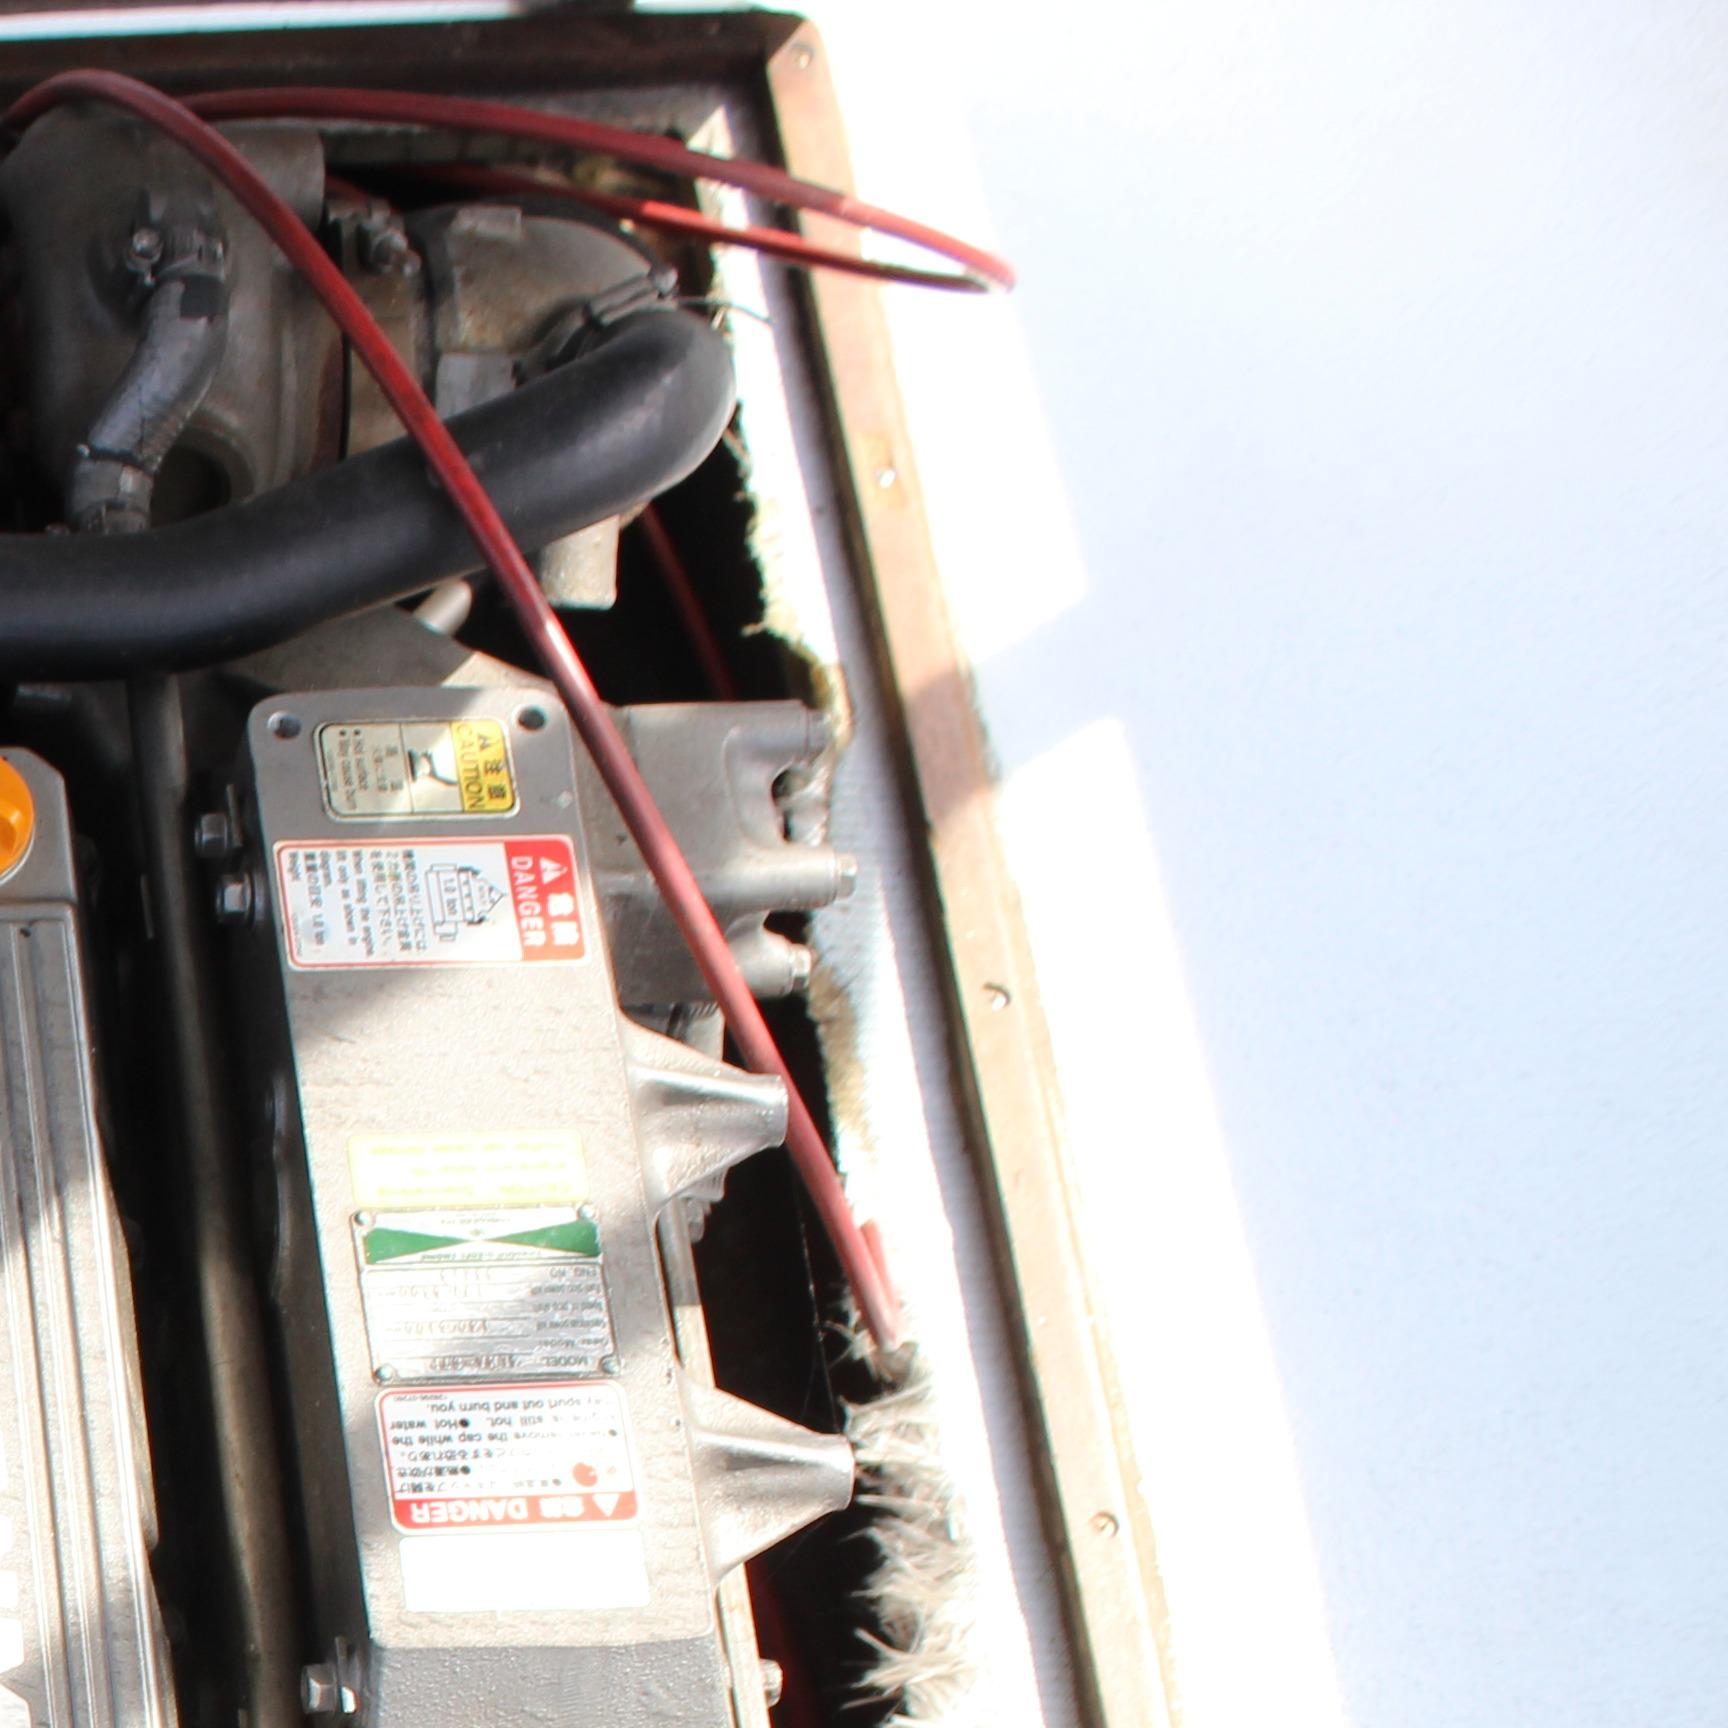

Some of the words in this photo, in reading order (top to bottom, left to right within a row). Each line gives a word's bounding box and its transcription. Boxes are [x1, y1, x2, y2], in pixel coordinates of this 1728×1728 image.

[457, 723, 486, 809] CAUTION
[511, 855, 545, 947] DANGER
[426, 1400, 455, 1412] you.
[460, 1401, 490, 1412] burn
[494, 1400, 518, 1411] and
[523, 1399, 544, 1410] out
[390, 1420, 426, 1431] water
[435, 1419, 458, 1430] Hot
[392, 1435, 413, 1446] the
[418, 1434, 453, 1446] while
[458, 1432, 482, 1442] cap
[487, 1431, 508, 1442] the
[410, 1497, 528, 1524] DANGER
